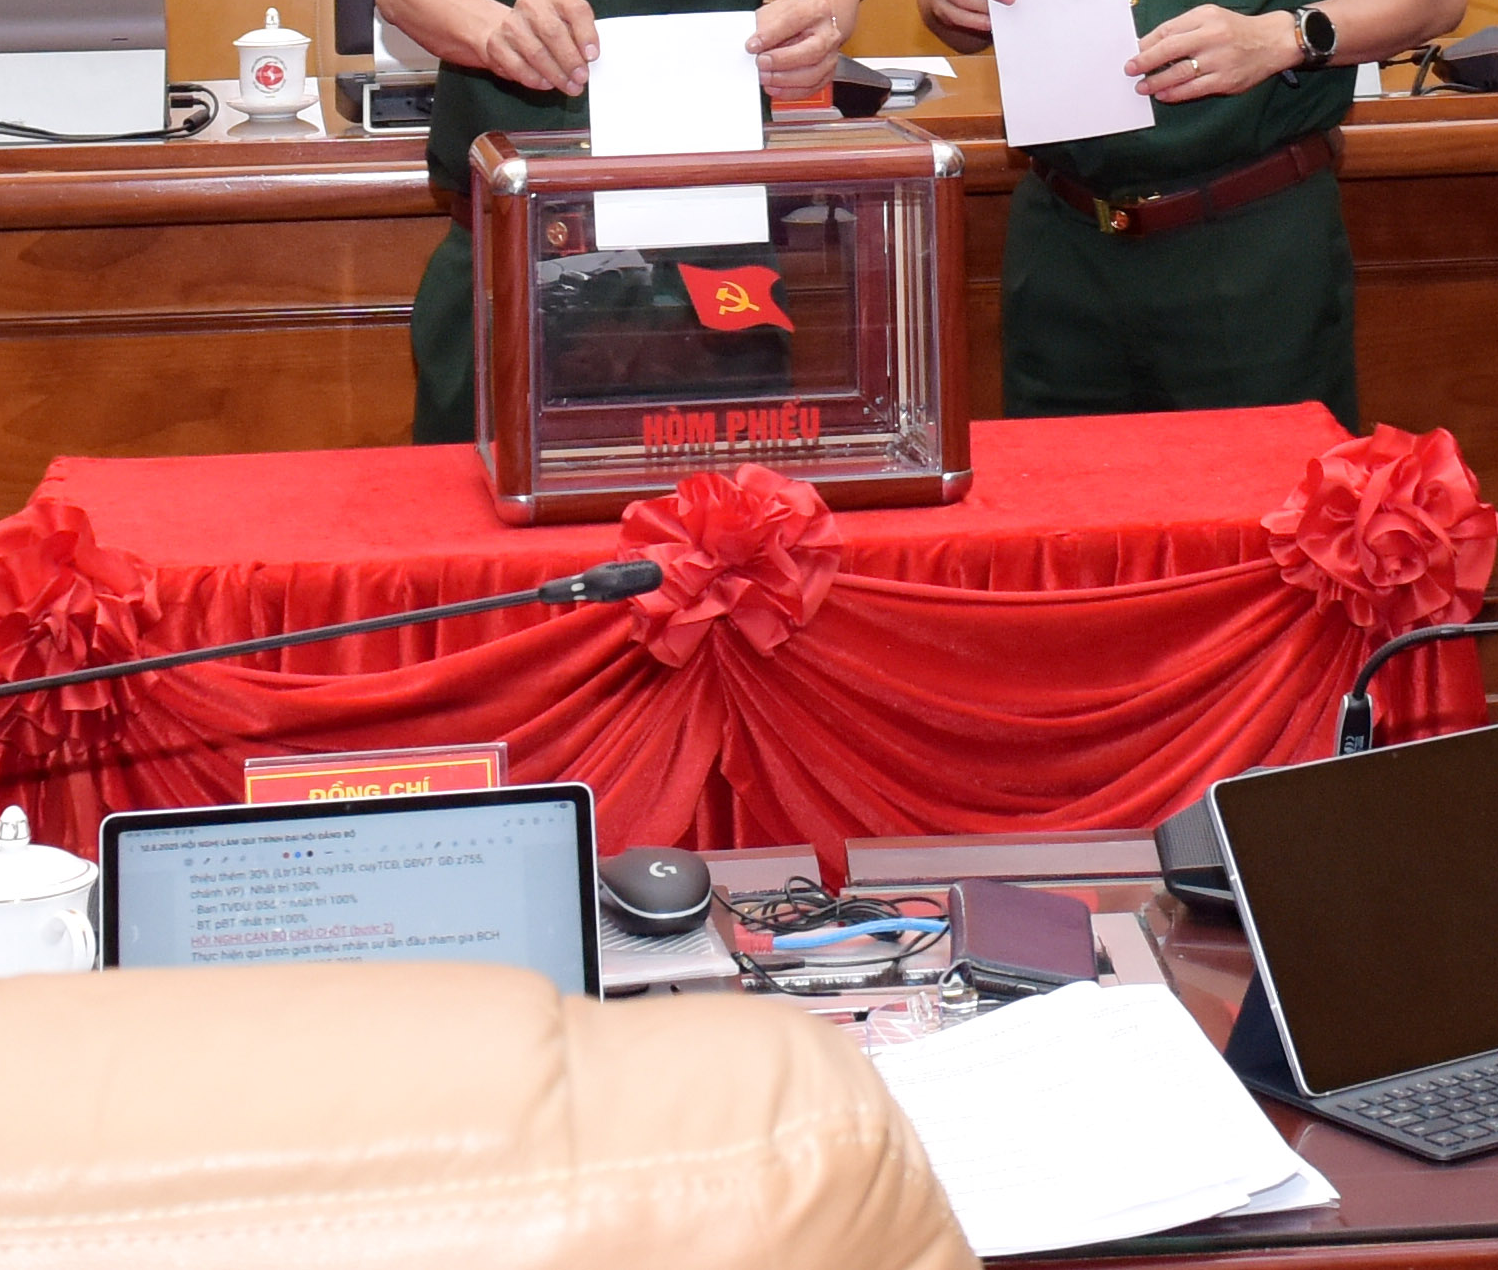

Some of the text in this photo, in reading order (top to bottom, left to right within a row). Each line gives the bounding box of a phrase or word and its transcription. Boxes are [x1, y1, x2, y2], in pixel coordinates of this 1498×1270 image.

[643, 395, 821, 445] HÒM PHIẾU
[309, 776, 431, 801] ĐỒNG CHÍ
